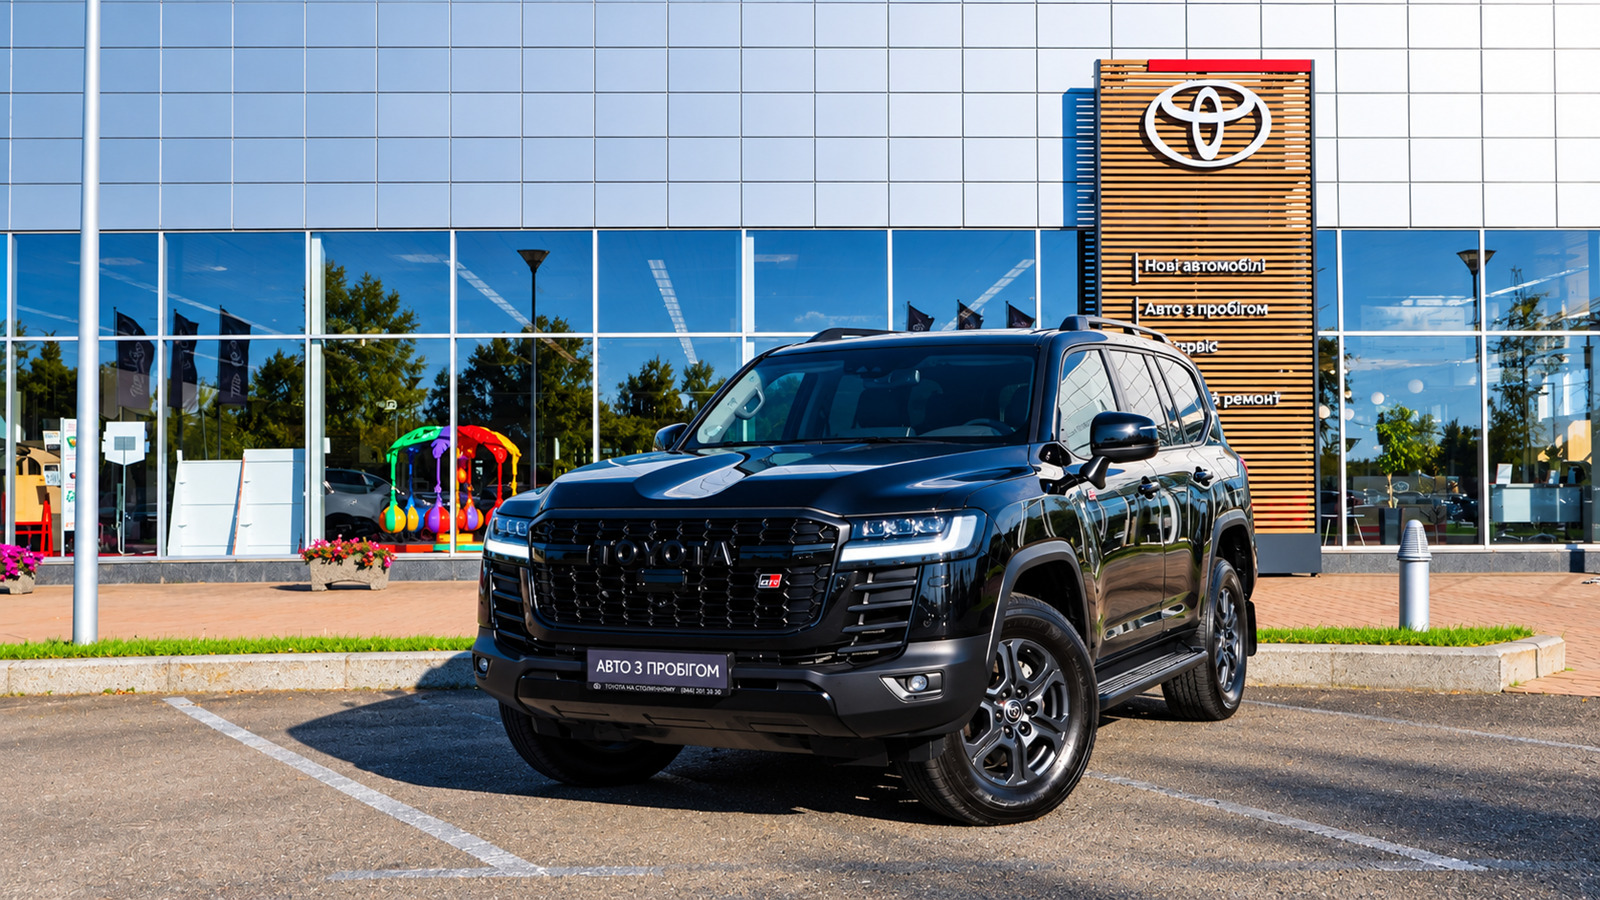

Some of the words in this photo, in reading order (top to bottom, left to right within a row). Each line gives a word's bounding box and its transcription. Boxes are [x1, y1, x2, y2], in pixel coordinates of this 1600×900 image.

[1144, 258, 1179, 272] Нові
[1182, 258, 1266, 273] автомобілі
[1144, 302, 1182, 316] Авто
[1186, 304, 1195, 316] з
[1197, 300, 1269, 319] пробігом
[1223, 391, 1282, 408] ремонт
[594, 539, 733, 566] TOYOTA
[596, 659, 632, 674] АВТО
[647, 661, 720, 678] ПРОБІГОМ
